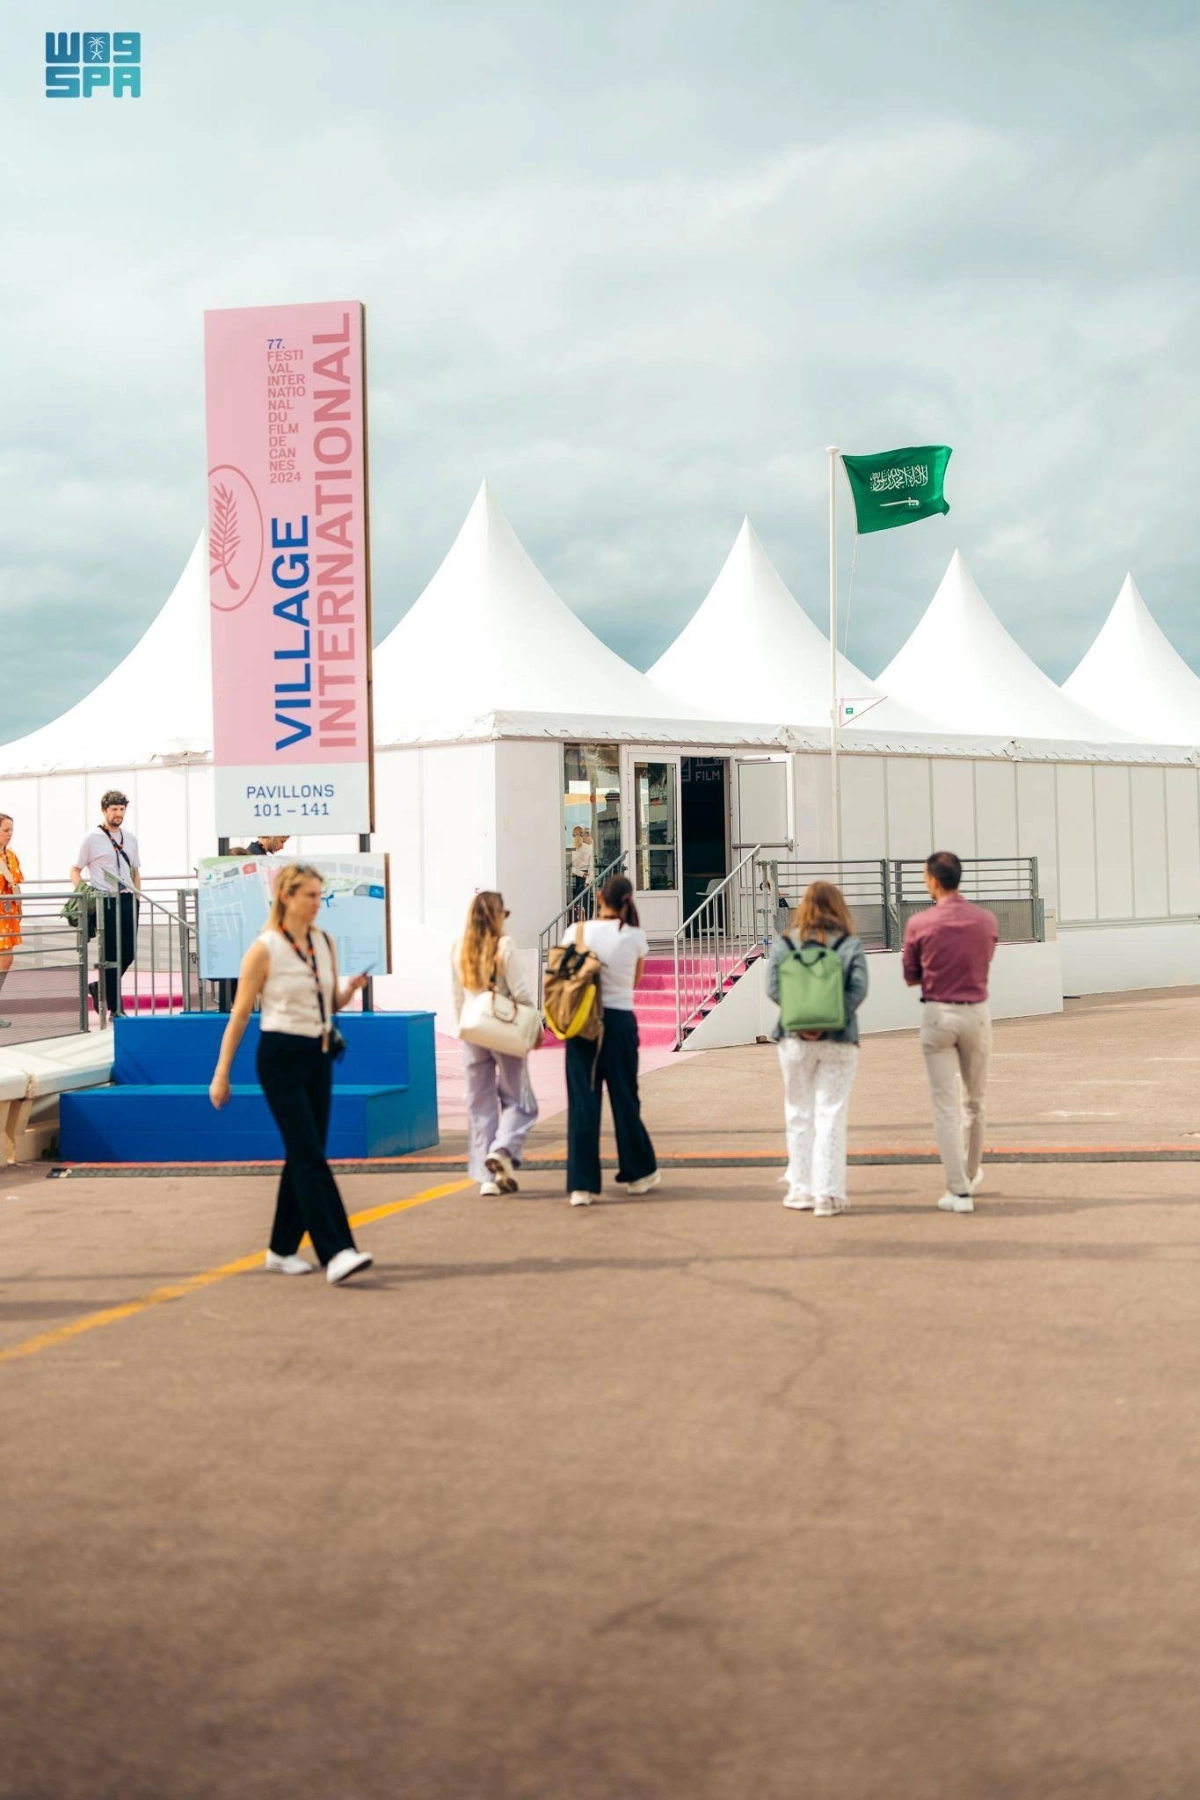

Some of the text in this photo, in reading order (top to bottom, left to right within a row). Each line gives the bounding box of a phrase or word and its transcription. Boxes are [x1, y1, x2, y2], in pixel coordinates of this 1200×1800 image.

[267, 338, 286, 350] 77.
[267, 350, 304, 362] FESTI
[267, 362, 294, 374] VAL
[267, 374, 305, 386] INTER
[267, 386, 306, 398] NATIO
[268, 399, 294, 411] NAL
[268, 412, 287, 423] DU
[268, 423, 299, 435] FILM
[269, 436, 287, 447] DE
[269, 448, 296, 459] CAN
[269, 460, 295, 471] NES
[270, 471, 302, 484] 2024
[312, 312, 357, 748] INTERNATIONAL
[271, 514, 312, 751] VILLAGE
[695, 770, 720, 781] FILM
[246, 784, 335, 799] PAVILLONS
[253, 804, 281, 817] 101
[301, 803, 330, 816] 141
